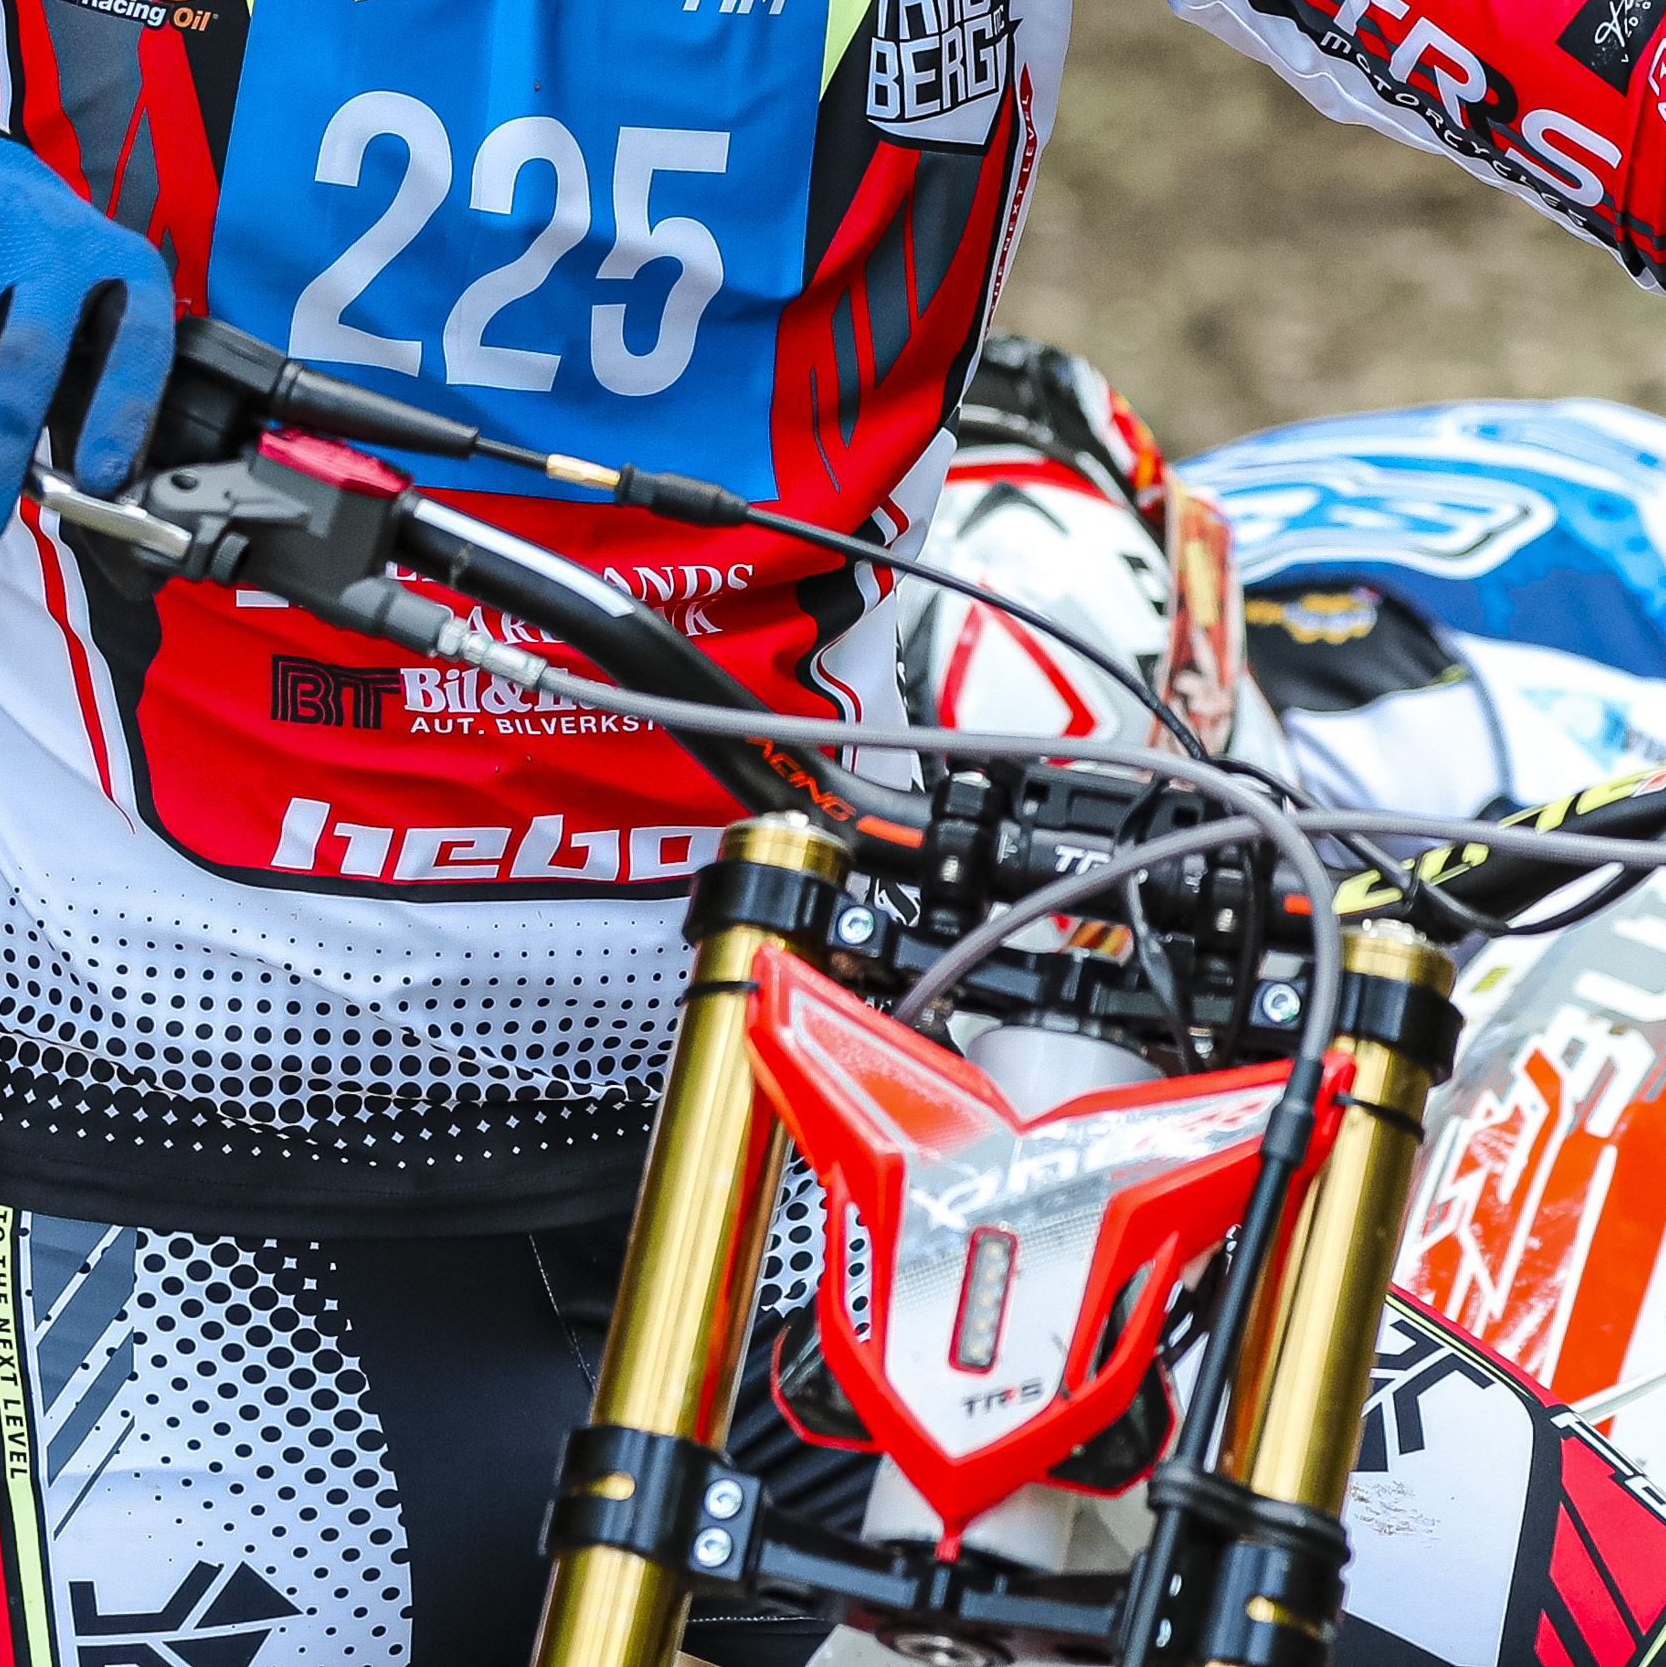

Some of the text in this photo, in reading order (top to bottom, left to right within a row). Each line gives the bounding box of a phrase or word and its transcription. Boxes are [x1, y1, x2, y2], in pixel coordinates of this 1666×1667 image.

[173, 7, 212, 32] Oil
[287, 89, 731, 397] 225
[410, 716, 485, 735] AUT.
[270, 797, 731, 883] hebo
[2, 1398, 29, 1479] LEVEL
